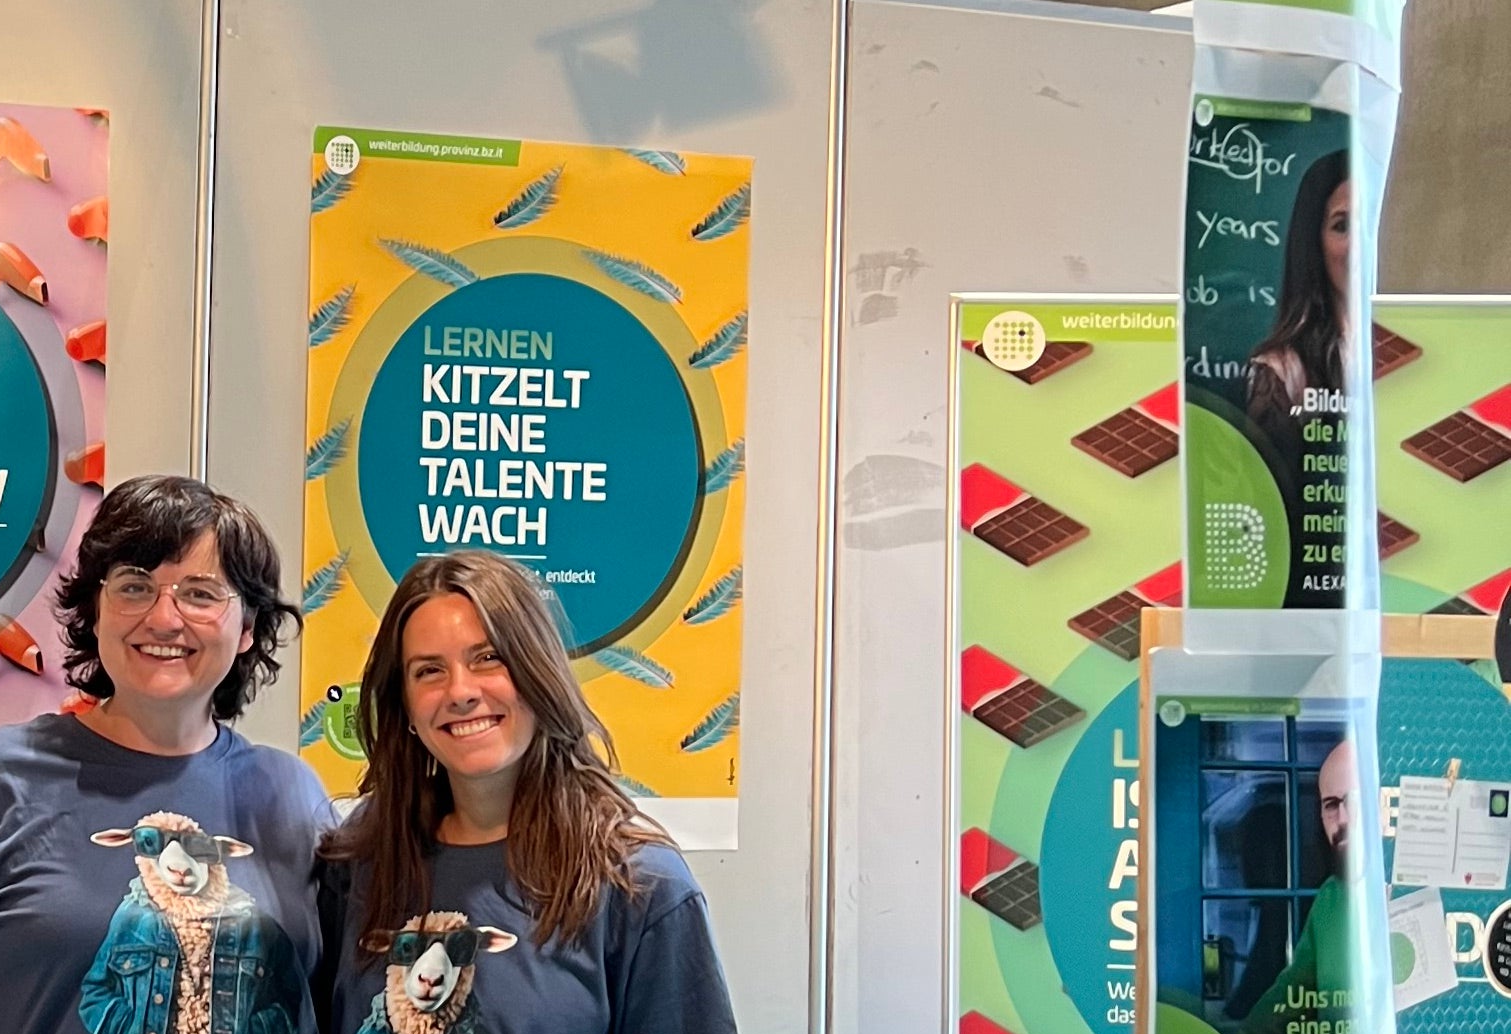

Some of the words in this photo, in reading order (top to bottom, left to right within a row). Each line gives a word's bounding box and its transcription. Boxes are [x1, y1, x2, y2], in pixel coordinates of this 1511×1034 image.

[1196, 210, 1280, 249] years
[1249, 285, 1276, 306] is
[1062, 311, 1179, 330] weiterbildun
[424, 325, 553, 361] LERNEN
[422, 364, 590, 409] KITZELT
[422, 410, 546, 453] DEINE
[1303, 419, 1332, 442] die
[419, 458, 608, 502] TALENTE
[418, 504, 547, 546] WACH
[1303, 545, 1326, 562] zu
[546, 568, 596, 584] entdeckt
